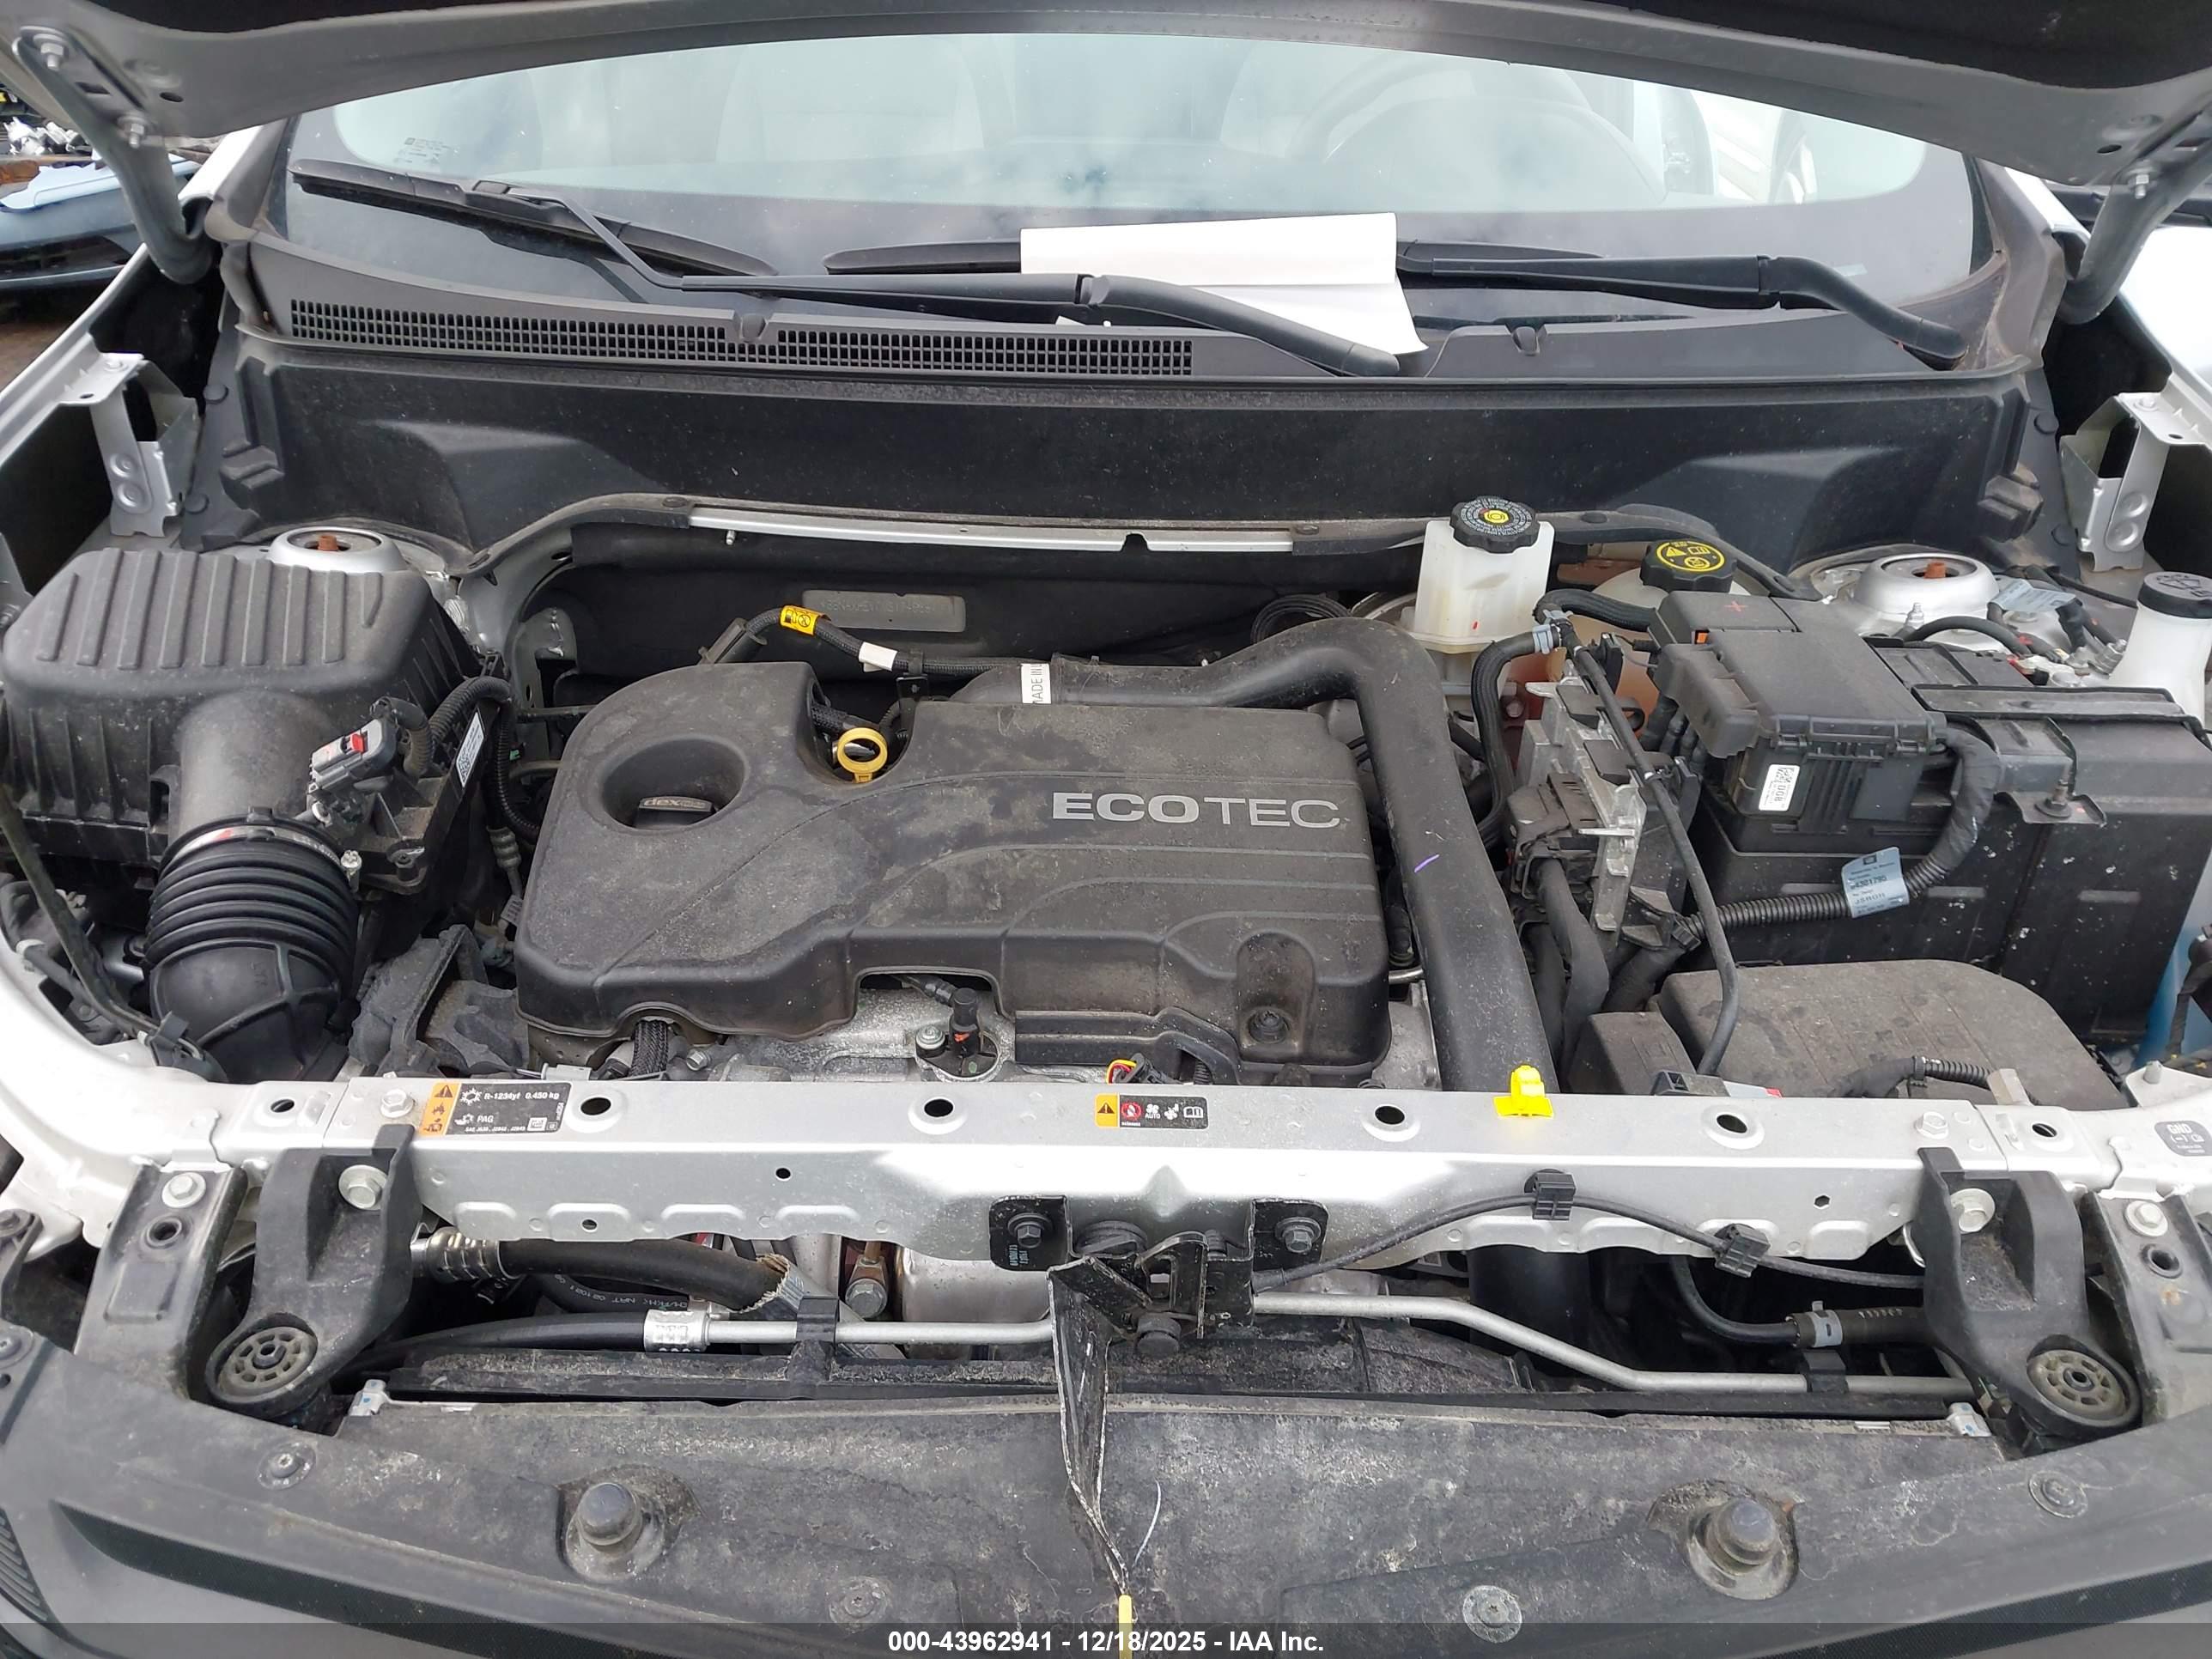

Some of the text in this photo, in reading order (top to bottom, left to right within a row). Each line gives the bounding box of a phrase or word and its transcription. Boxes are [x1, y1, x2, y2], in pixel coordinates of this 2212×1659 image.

[1053, 793, 1340, 828] ECOTEC
[483, 1091, 521, 1100] R-1234yf
[525, 1091, 548, 1100] 0.450
[2166, 1123, 2193, 1134] GND
